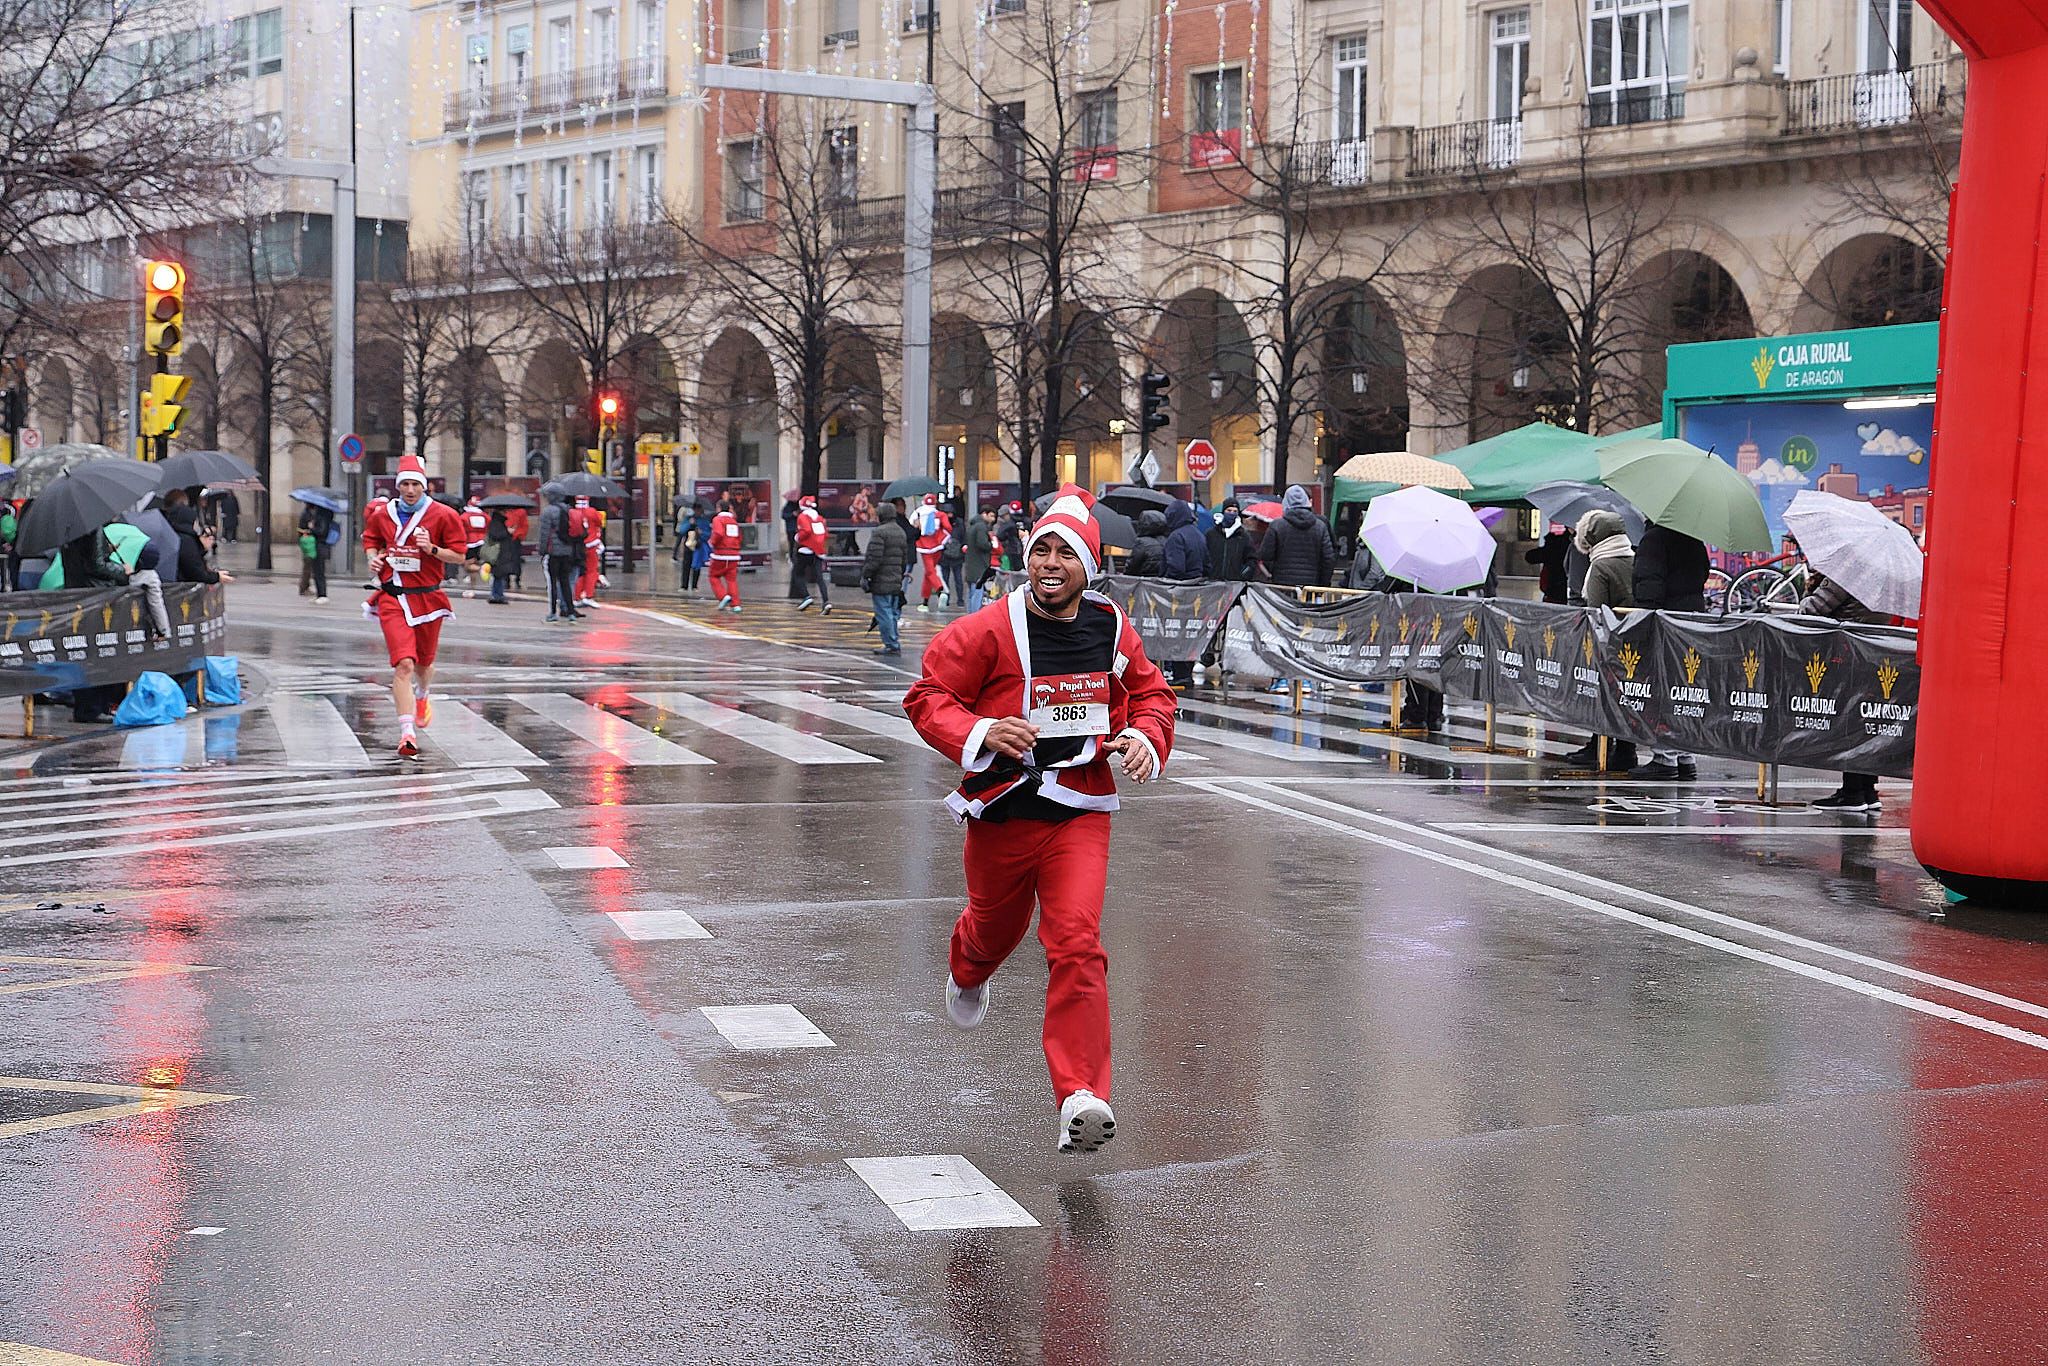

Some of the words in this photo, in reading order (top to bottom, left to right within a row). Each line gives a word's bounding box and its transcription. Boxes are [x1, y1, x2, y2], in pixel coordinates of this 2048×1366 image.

[1778, 344, 1809, 367] CAJA
[1810, 341, 1852, 364] RURAL
[1786, 371, 1799, 388] DE
[1801, 366, 1844, 386] ARAGÓN
[1188, 454, 1213, 465] STOP
[1788, 443, 1814, 464] in
[1085, 678, 1105, 689] Noel
[1624, 682, 1652, 698] RURAL
[1670, 686, 1688, 701] CAJA
[1730, 691, 1747, 707] CAJA
[1052, 705, 1087, 722] 3863
[1673, 705, 1682, 716] DE
[1790, 696, 1810, 712] CAJA
[1811, 698, 1837, 715] RURAL
[1860, 702, 1881, 719] CAJA
[1881, 704, 1912, 721] RURAL
[1733, 711, 1741, 722] DE
[1795, 716, 1804, 728] DE
[1805, 717, 1831, 731] ARAGÓN
[1865, 723, 1877, 735] DE
[1878, 723, 1904, 737] ARAGÓN
